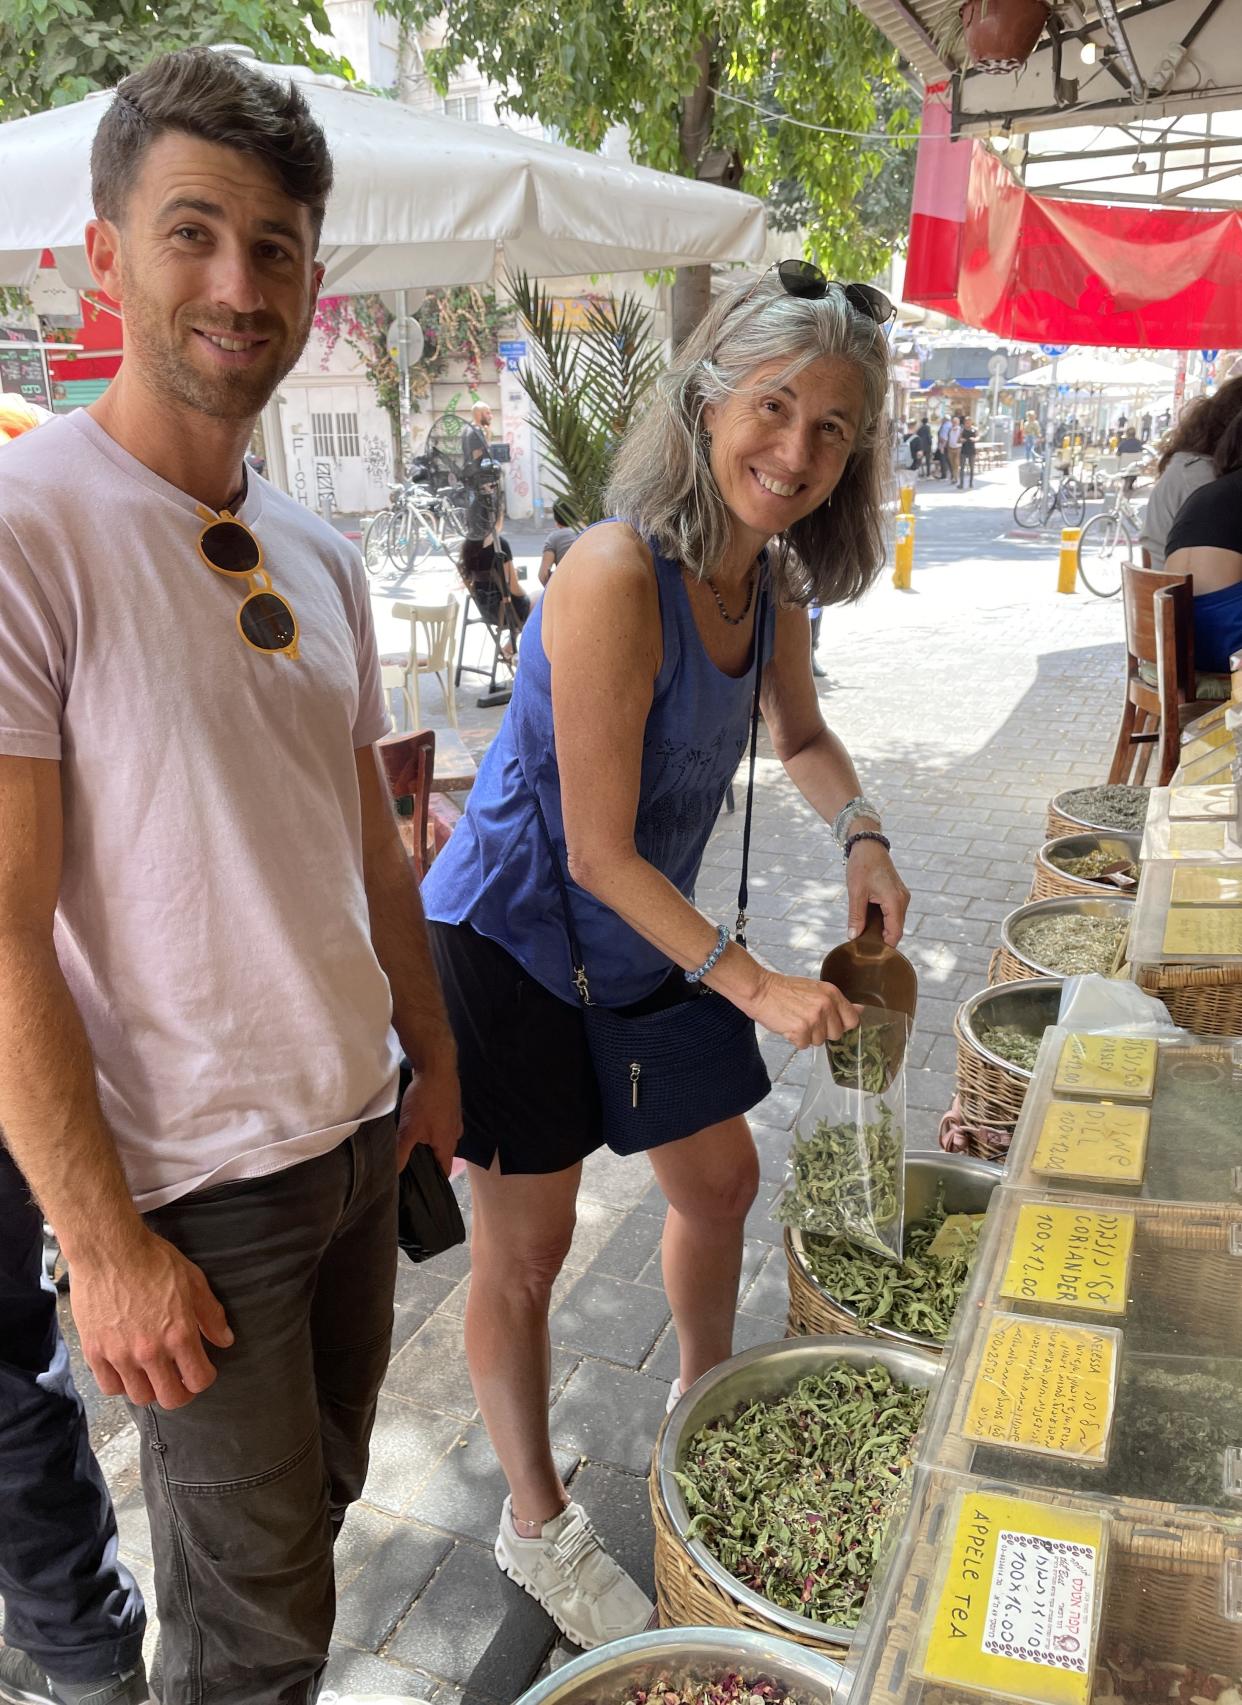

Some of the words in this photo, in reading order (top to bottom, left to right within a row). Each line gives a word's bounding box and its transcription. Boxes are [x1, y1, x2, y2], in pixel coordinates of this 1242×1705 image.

[291, 437, 308, 506] FISH
[1077, 1110, 1105, 1146] DILL
[1085, 1274, 1114, 1305] עלי
[1076, 1391, 1103, 1448] מליסה
[1071, 1578, 1084, 1604] אטלס
[1068, 1611, 1081, 1634] קפה
